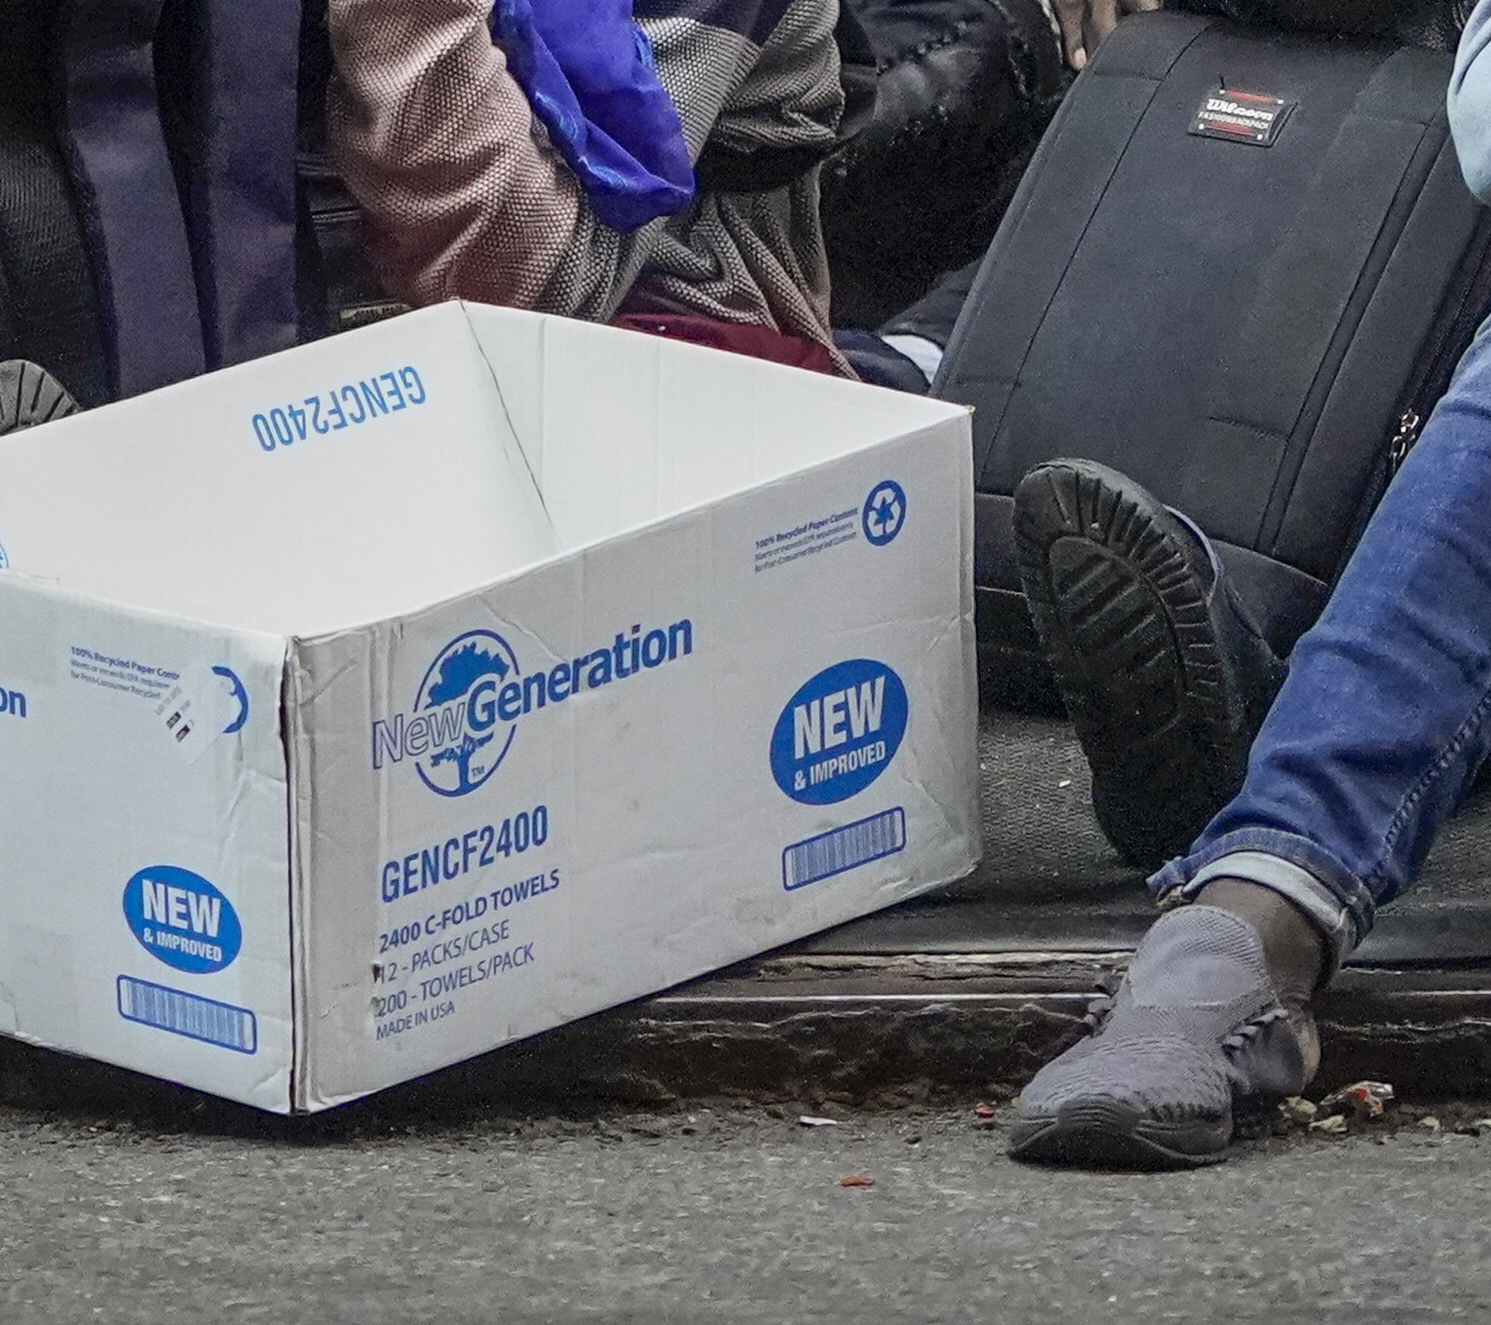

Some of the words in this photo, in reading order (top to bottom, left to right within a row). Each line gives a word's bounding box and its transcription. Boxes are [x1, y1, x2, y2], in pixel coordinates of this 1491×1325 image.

[251, 365, 427, 452] GENCF2400
[794, 675, 885, 760] NEW
[794, 769, 806, 791] &
[810, 740, 886, 786] IMPROVED
[381, 804, 548, 903] GENCF2400
[141, 878, 221, 938] NEW
[379, 922, 421, 954] 2400
[425, 897, 488, 935] C-FOLD
[490, 868, 561, 911] TOWELS
[143, 927, 153, 944] &
[156, 930, 223, 963] IMPROVED
[411, 919, 510, 974] PACKS/CASE
[420, 942, 535, 1001] TOWELS/PACK
[376, 1014, 412, 1040] MADE
[414, 1009, 428, 1026] IN
[430, 1001, 455, 1020] USA
